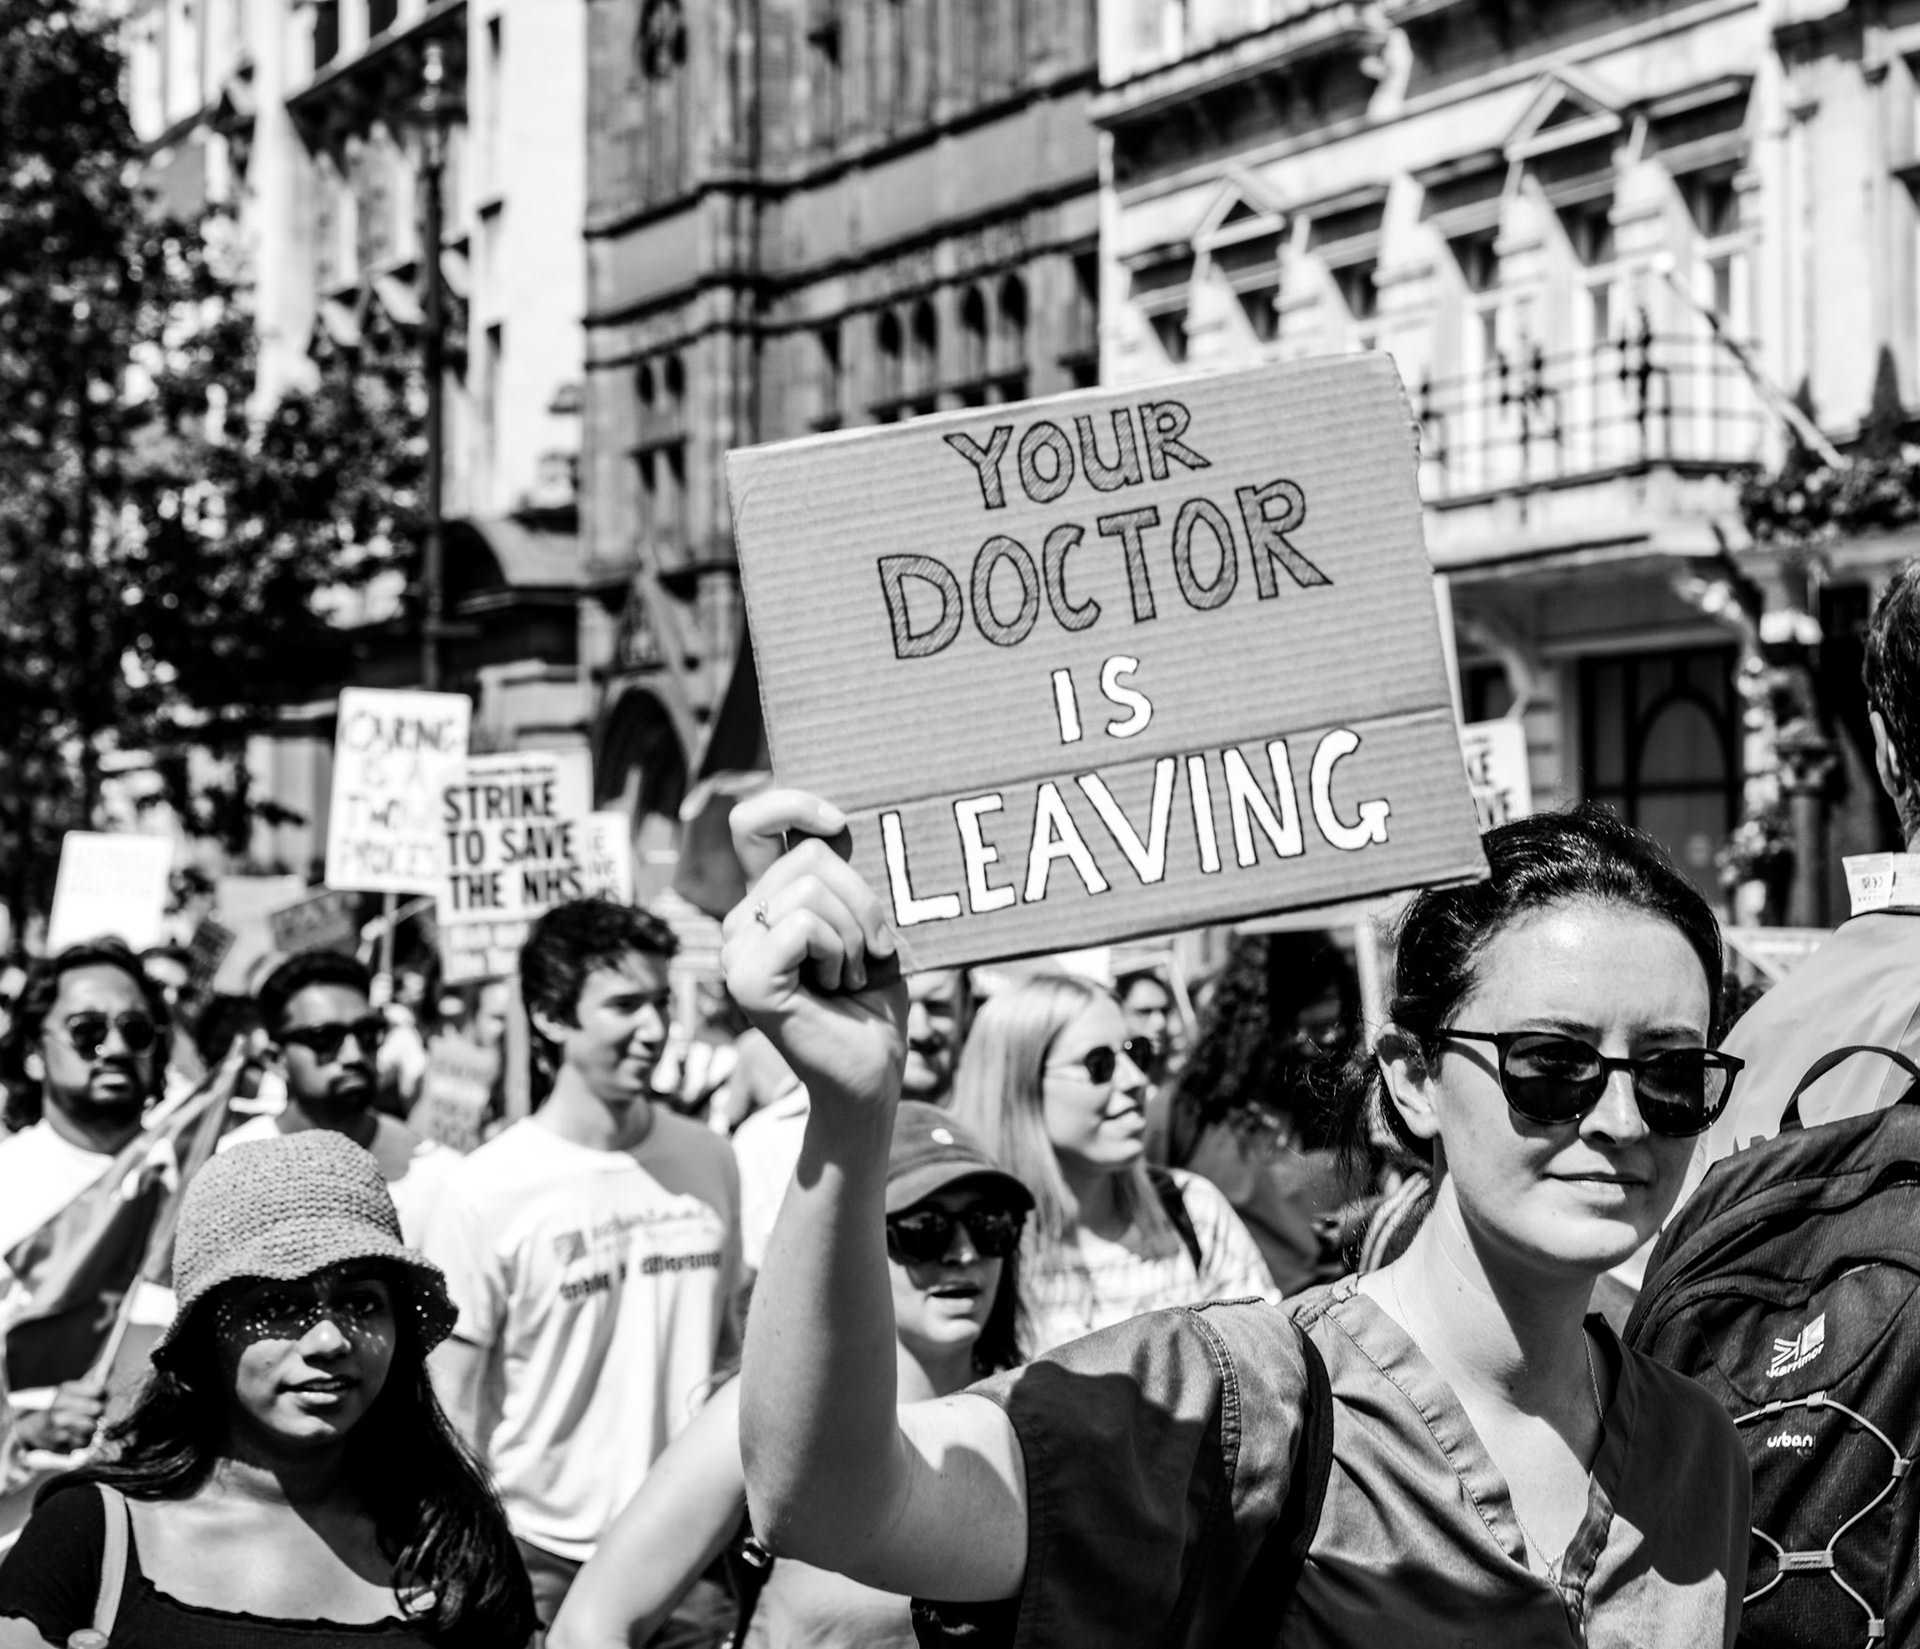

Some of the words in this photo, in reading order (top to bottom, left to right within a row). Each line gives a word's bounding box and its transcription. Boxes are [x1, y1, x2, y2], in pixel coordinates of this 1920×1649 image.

[943, 400, 1211, 510] YOUR
[877, 479, 1333, 659] DOCTOR
[1051, 654, 1153, 745] IS
[443, 779, 556, 824] STRIKE
[446, 828, 486, 867] TO
[500, 819, 576, 864] SAVE
[879, 727, 1391, 926] LEAVING
[449, 871, 504, 911] THE
[523, 864, 584, 904] NHS
[1766, 1343, 1825, 1378] karrimor
[1767, 1430, 1813, 1448] urban
